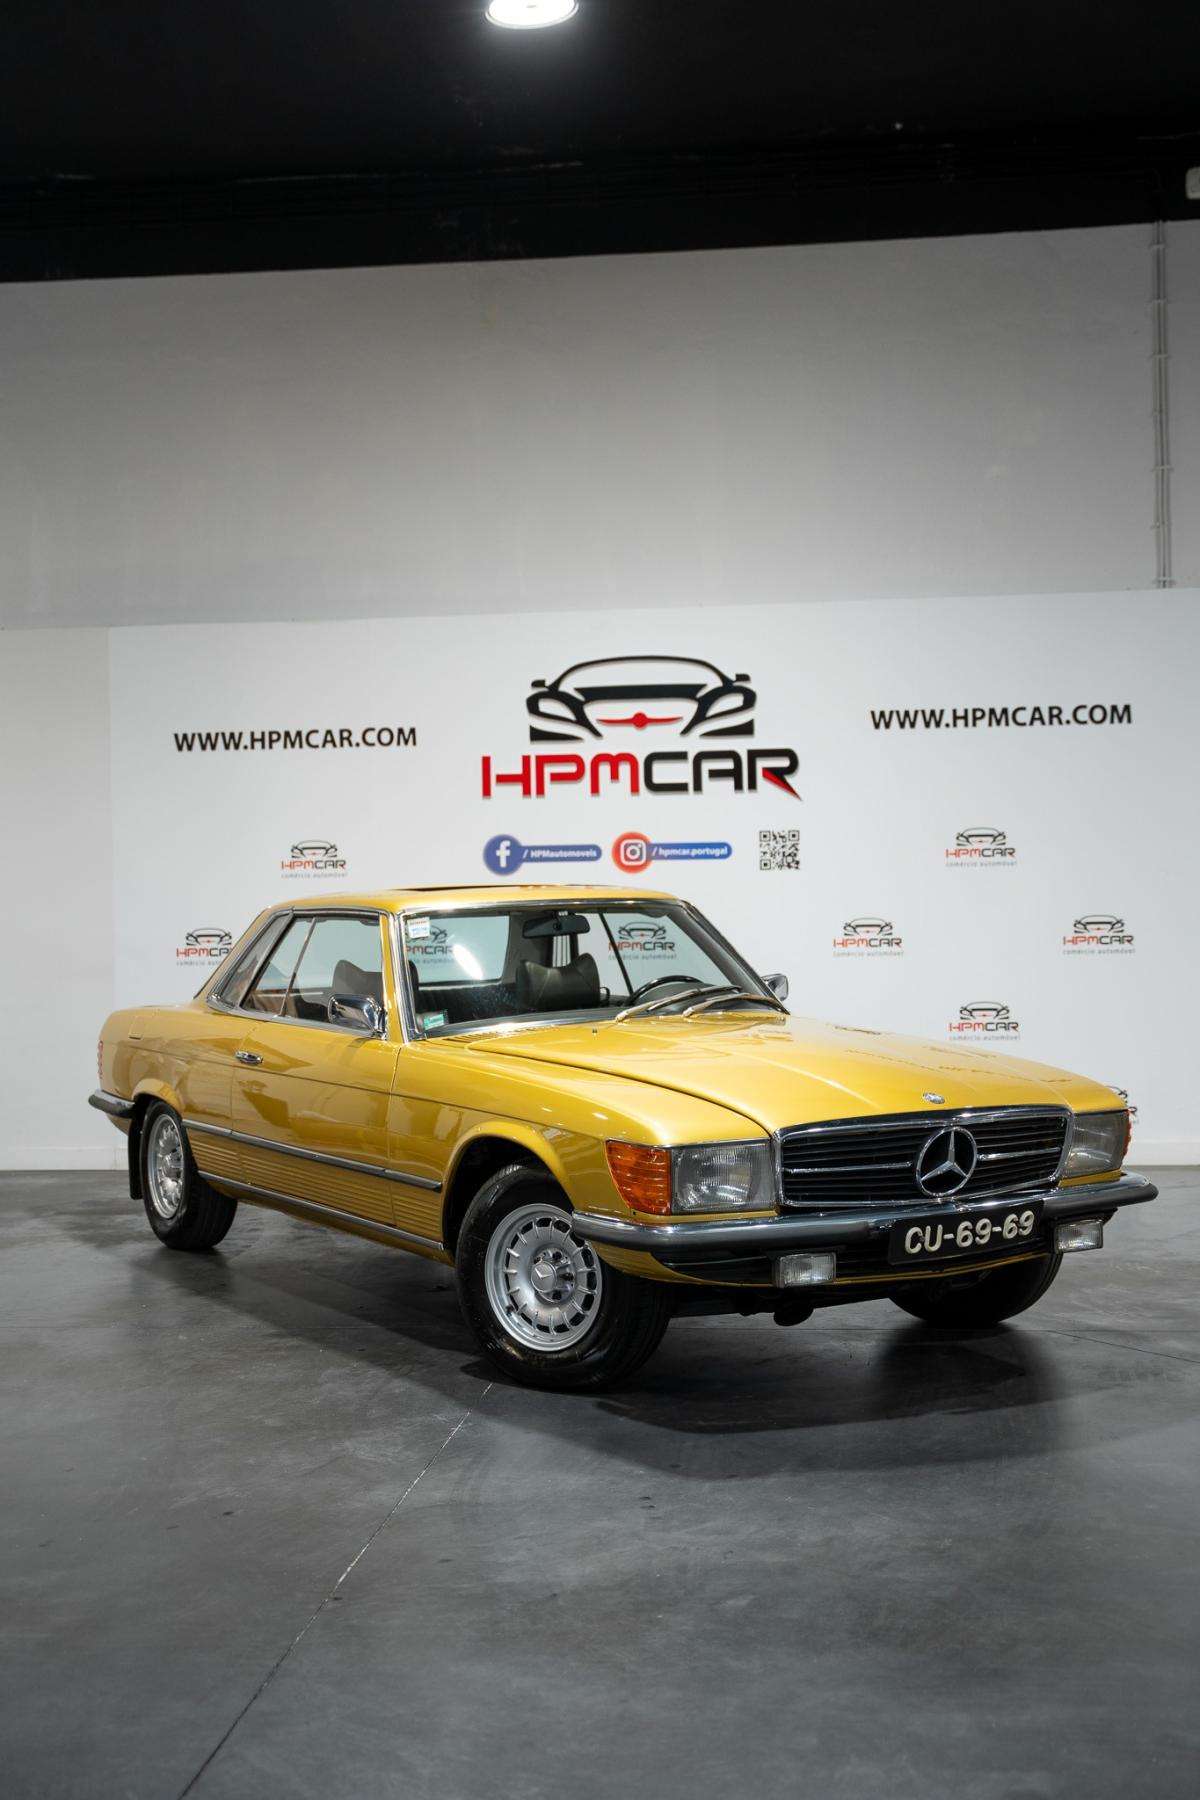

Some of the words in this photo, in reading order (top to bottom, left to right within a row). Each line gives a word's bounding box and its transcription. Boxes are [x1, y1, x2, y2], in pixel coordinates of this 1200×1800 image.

[870, 704, 1132, 730] WWW.HPMCAR.COM
[174, 727, 417, 752] WWW.HPMCAR.COM
[482, 748, 802, 799] HPMCAR
[945, 847, 1016, 858] HPMCAR
[281, 859, 346, 870] HPMCAR
[833, 937, 902, 948] HPMCAR
[1063, 935, 1134, 946] HPMCAR
[176, 947, 233, 957] HPMCA
[949, 1022, 1019, 1032] HPMCAR
[904, 1210, 1036, 1254] CU-69-69
